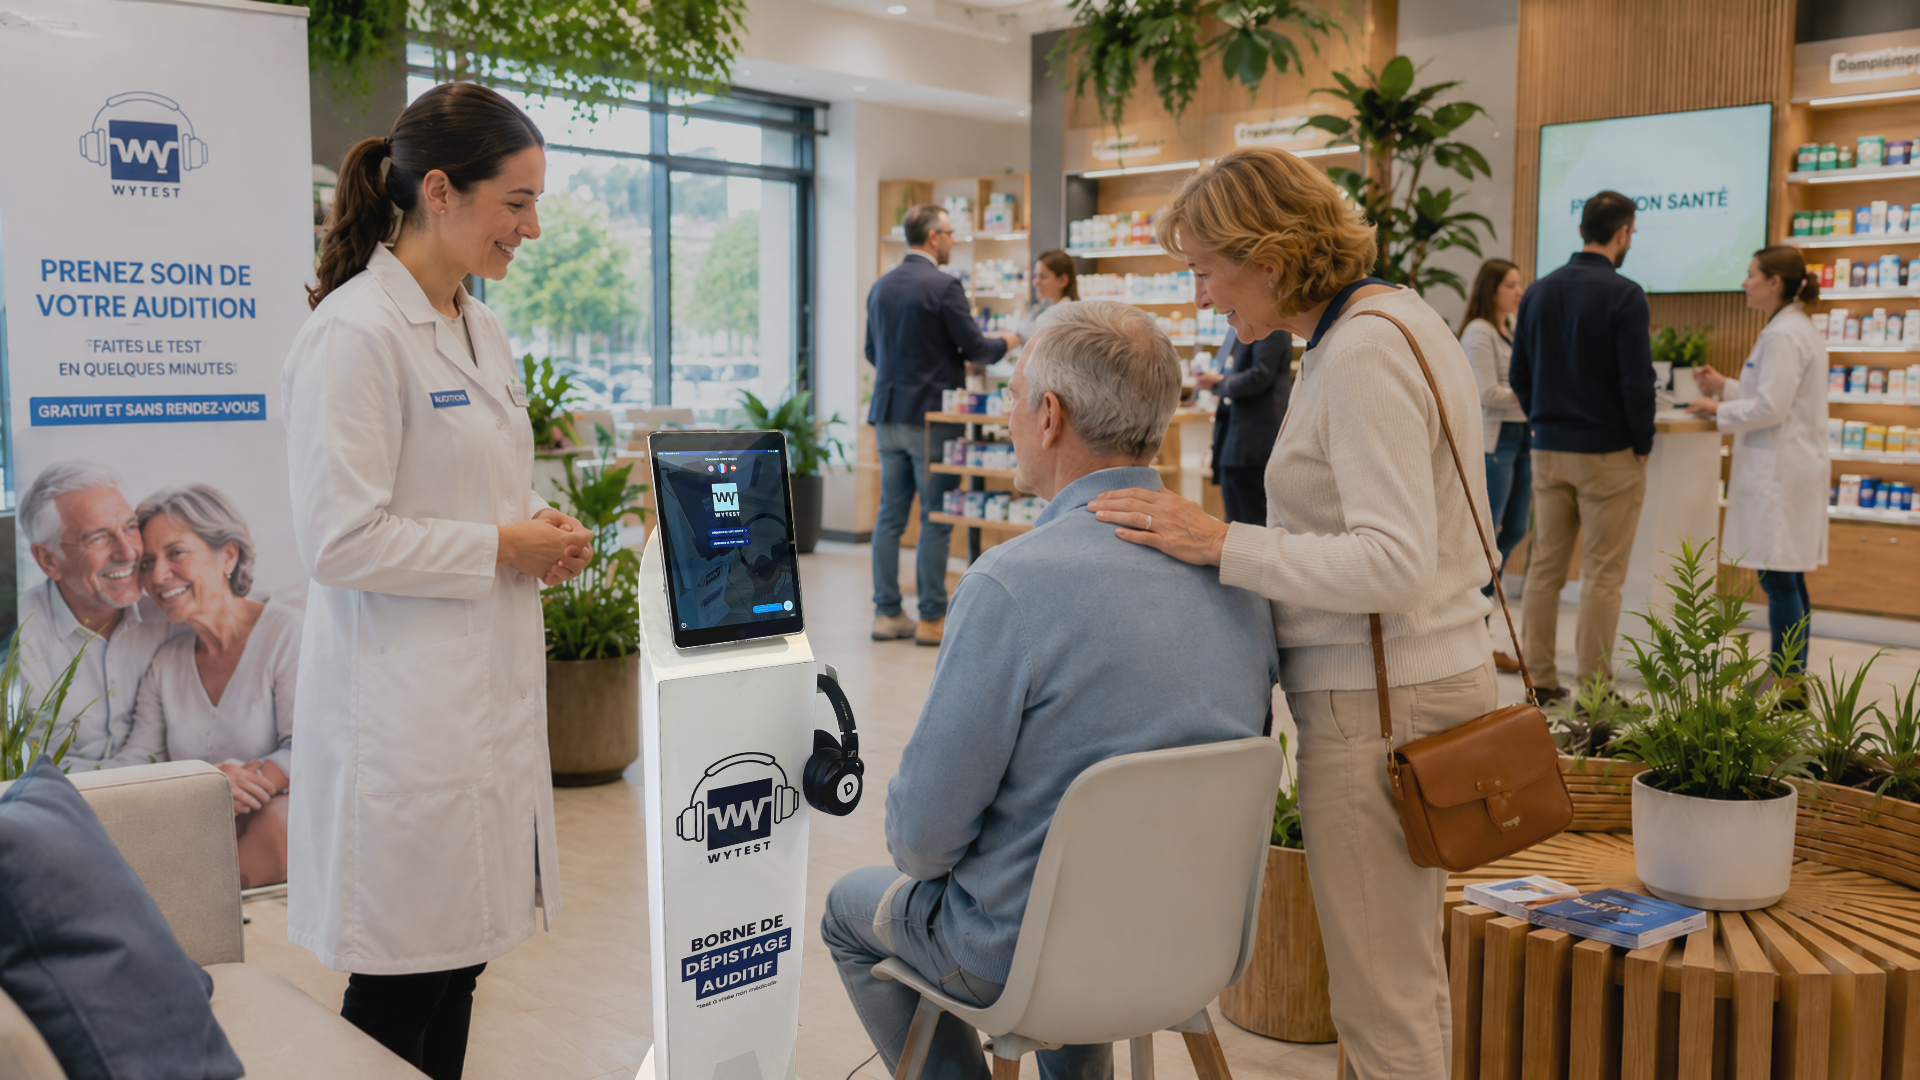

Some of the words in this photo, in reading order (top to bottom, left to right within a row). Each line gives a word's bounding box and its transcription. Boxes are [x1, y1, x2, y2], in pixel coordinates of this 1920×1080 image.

[111, 184, 181, 198] WYTEST
[1667, 186, 1728, 210] SANTÉ
[40, 259, 145, 284] PRENEZ
[150, 262, 213, 285] SOIN
[220, 264, 251, 286] DE
[36, 293, 127, 317] VOTRE
[132, 296, 256, 319] AUDITION
[93, 339, 143, 353] FAITES
[147, 340, 163, 353] LE
[166, 339, 201, 353] TEST
[59, 362, 80, 376] EN
[84, 362, 165, 378] QUELQUES
[169, 362, 234, 376] MINUTES
[38, 403, 103, 418] GRATUIT
[106, 403, 122, 417] ET
[125, 402, 163, 416] SANS
[166, 401, 260, 416] RENDEZ-VOUS
[707, 840, 771, 864] WYTEST
[691, 922, 757, 953] BORNE
[760, 914, 784, 933] DE
[685, 935, 788, 977] DÉPISTAGE
[701, 960, 774, 995] AUDITIF
[735, 989, 748, 997] non
